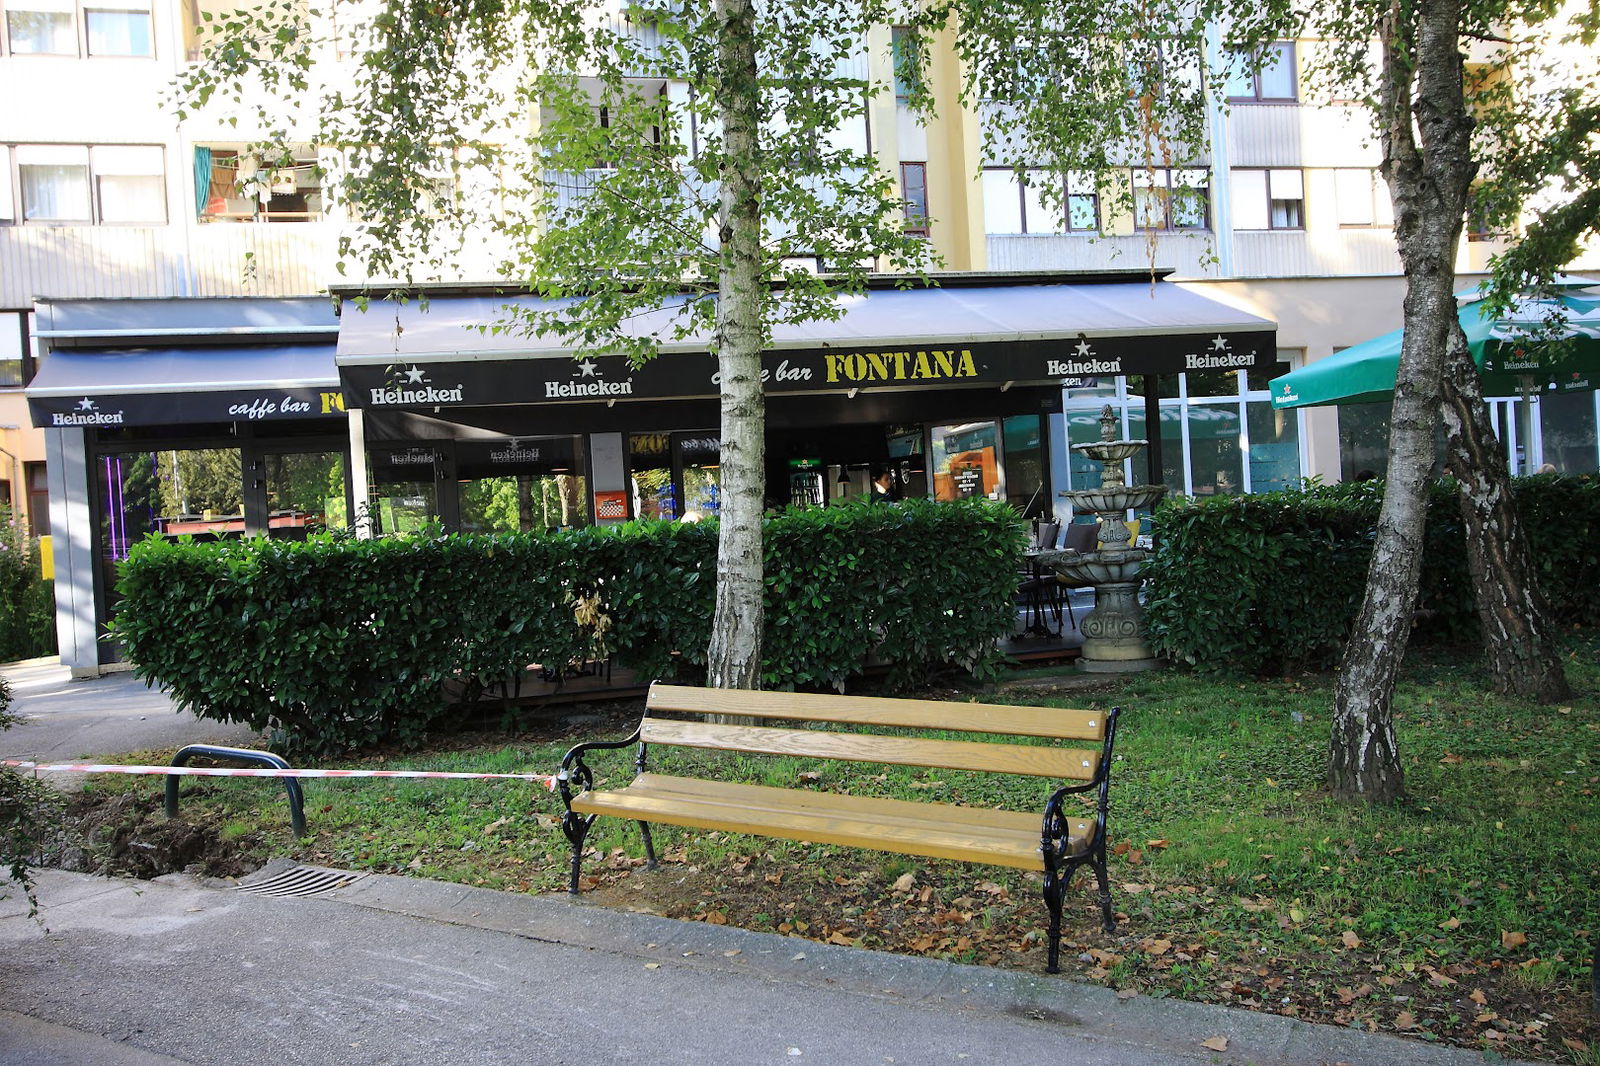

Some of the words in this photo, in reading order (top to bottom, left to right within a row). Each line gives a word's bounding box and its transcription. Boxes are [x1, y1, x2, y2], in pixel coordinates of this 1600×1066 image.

[775, 359, 813, 382] bar
[824, 349, 978, 383] FONTANA
[1046, 359, 1122, 376] Heineken
[1185, 353, 1256, 369] Heineken
[370, 386, 463, 405] Heineken
[545, 378, 633, 398] Heineken
[228, 398, 276, 420] caffe
[279, 396, 311, 413] bar
[52, 411, 123, 426] Heineken
